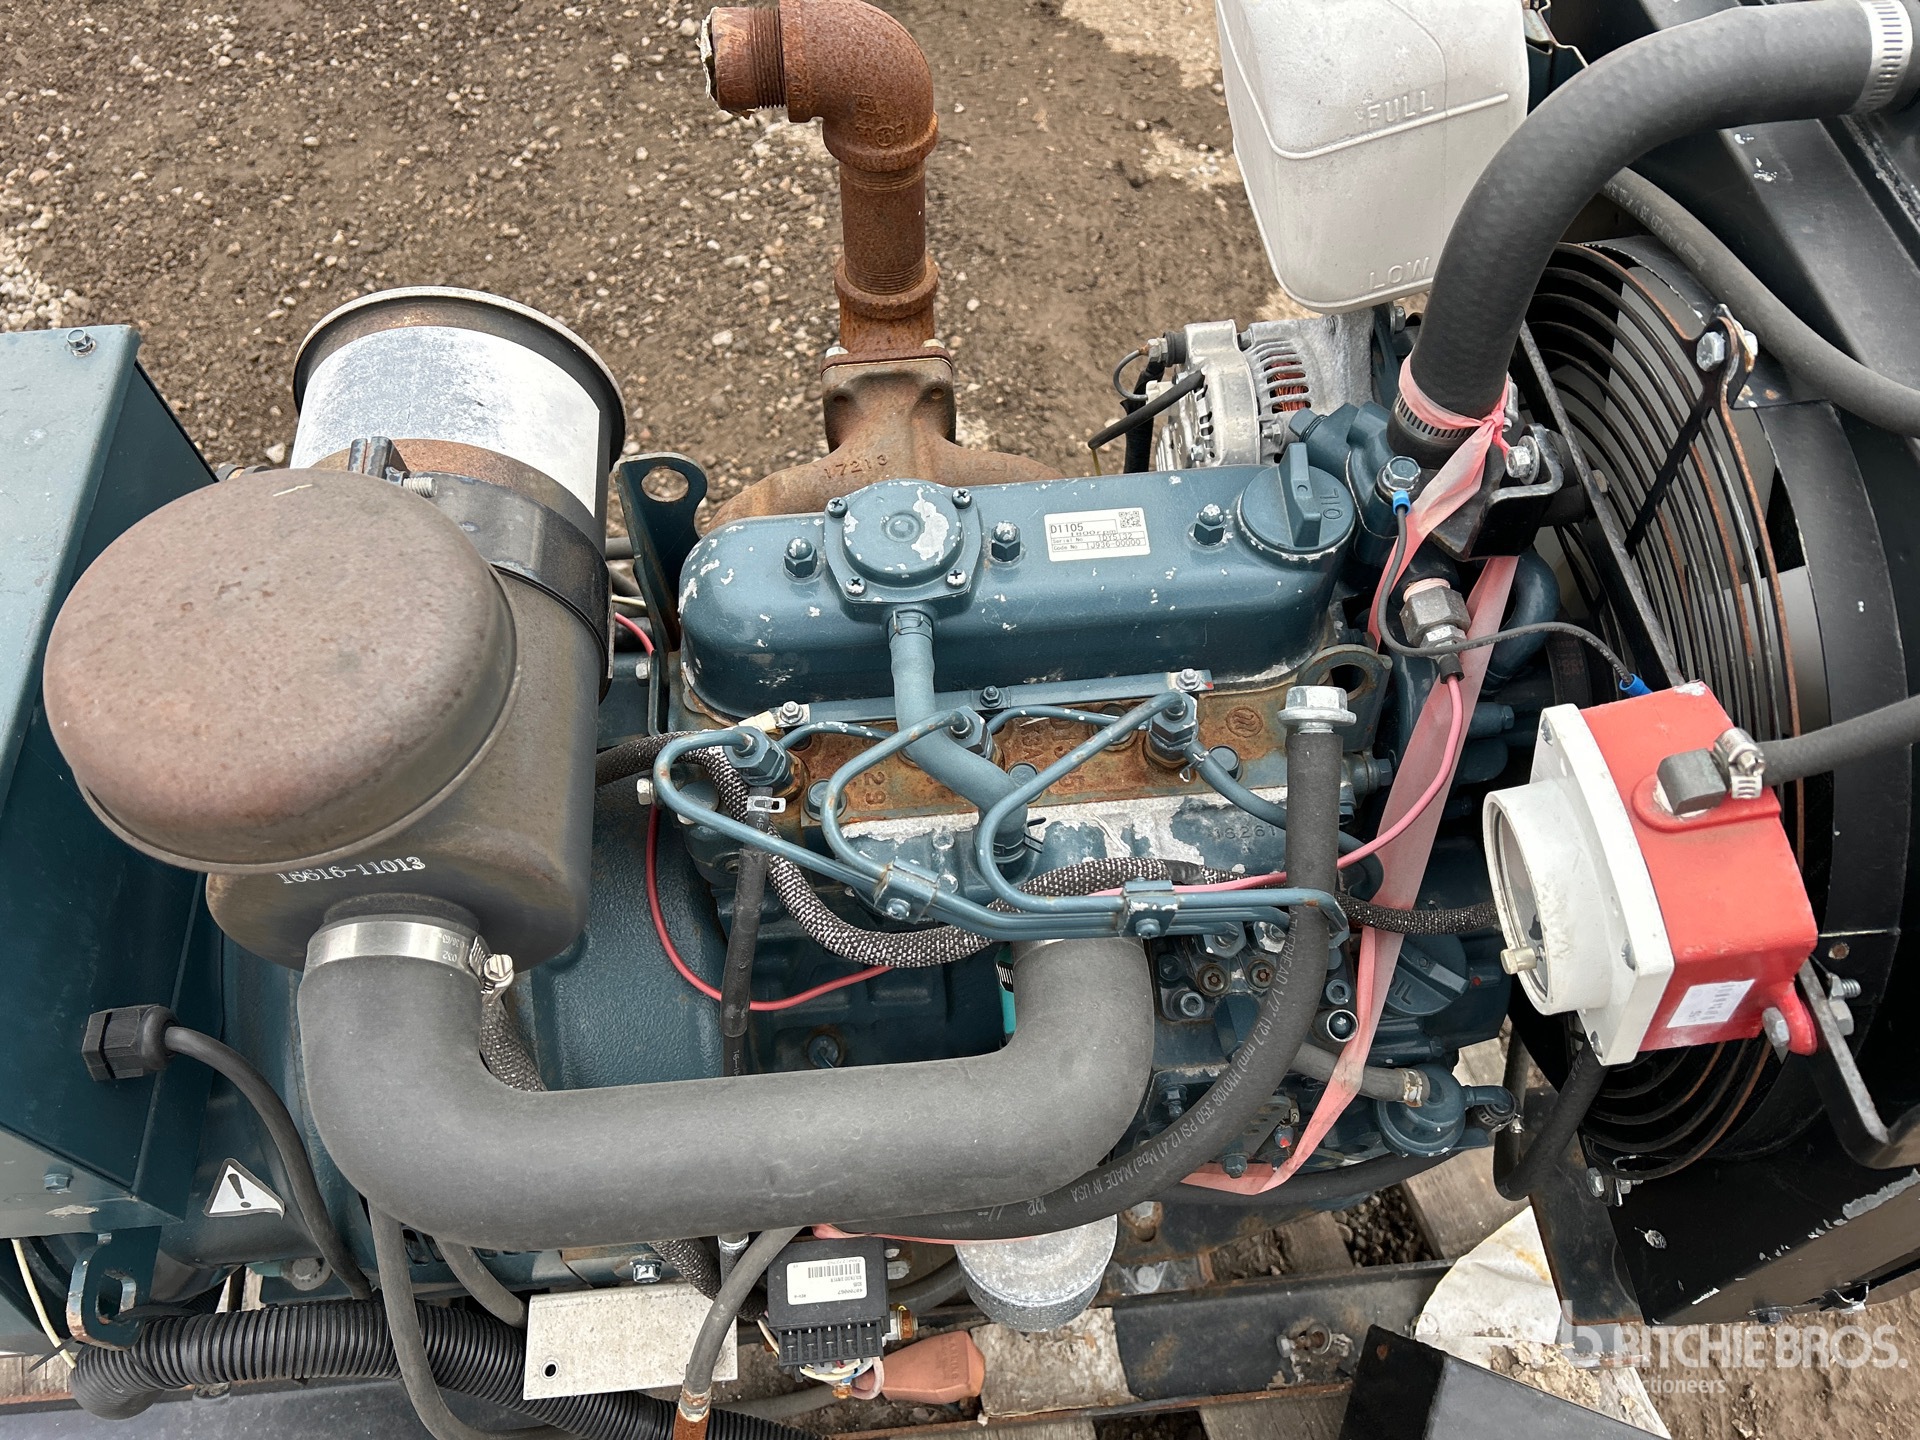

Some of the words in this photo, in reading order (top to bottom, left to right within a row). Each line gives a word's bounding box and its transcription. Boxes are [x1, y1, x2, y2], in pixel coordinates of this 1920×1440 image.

[1366, 90, 1434, 127] FULL
[1369, 256, 1429, 290] LOW
[824, 454, 889, 479] 17213
[1320, 488, 1342, 519] OIL
[1050, 523, 1084, 534] D1105
[275, 856, 426, 884] 16616-11013
[1195, 1101, 1215, 1124] 350
[1180, 1118, 1198, 1140] PSI
[1092, 1178, 1104, 1195] IN
[1103, 1163, 1133, 1190] MADE
[1070, 1183, 1091, 1203] USA
